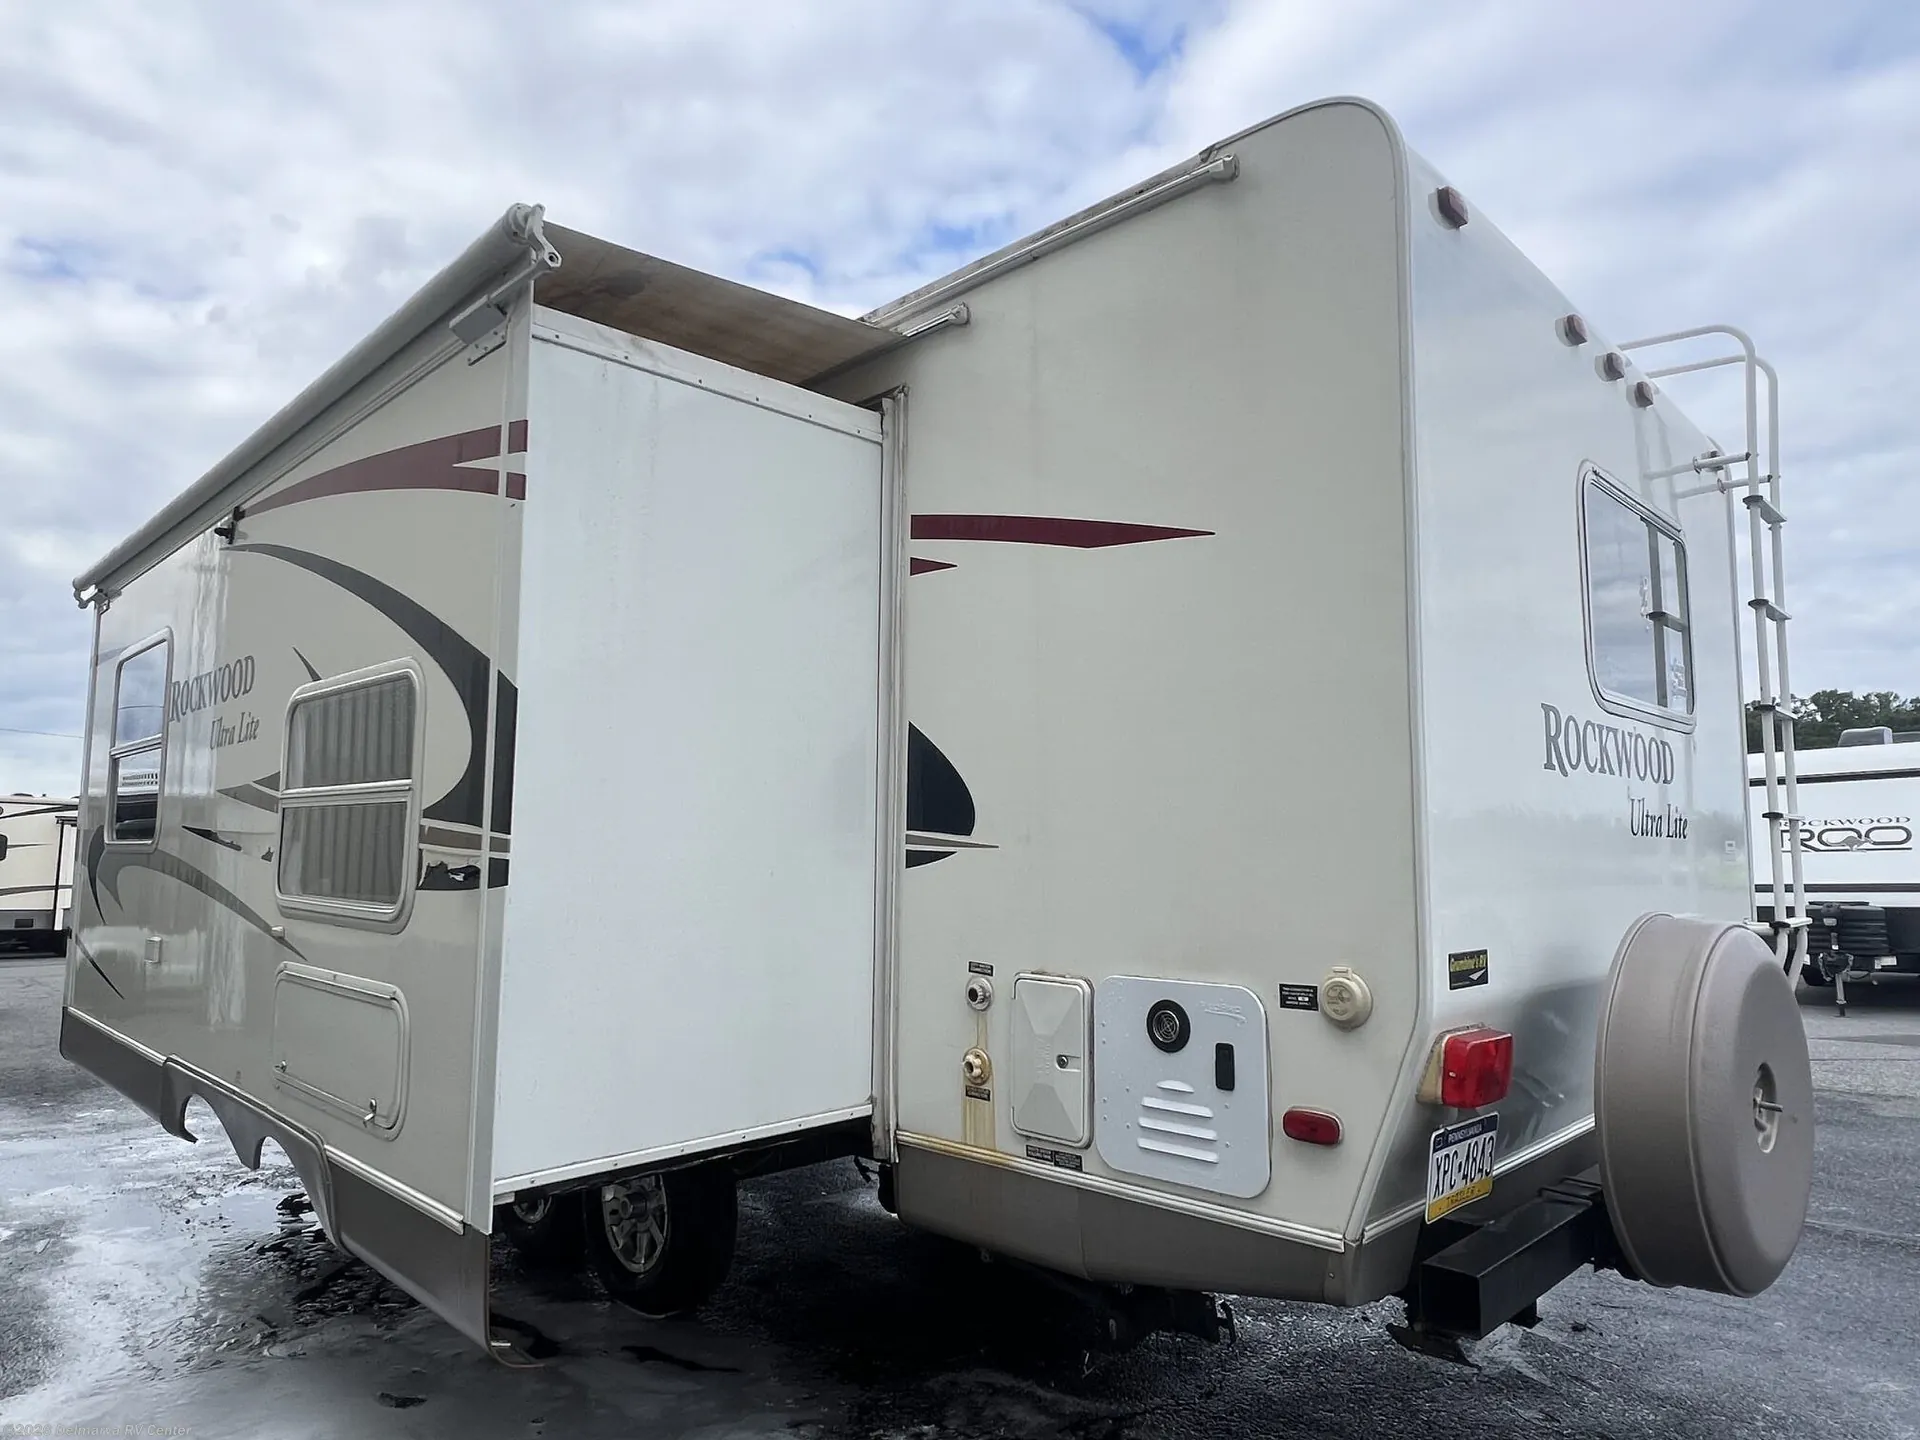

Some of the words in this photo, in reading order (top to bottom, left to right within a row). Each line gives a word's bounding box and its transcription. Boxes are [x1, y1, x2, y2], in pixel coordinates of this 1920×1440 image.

[169, 655, 255, 723] ROCKWOOD
[210, 716, 236, 750] Ultra
[238, 711, 259, 744] Lite
[1541, 703, 1675, 785] ROCKWOOD
[1630, 797, 1663, 838] Ultra
[1666, 803, 1688, 839] Lite
